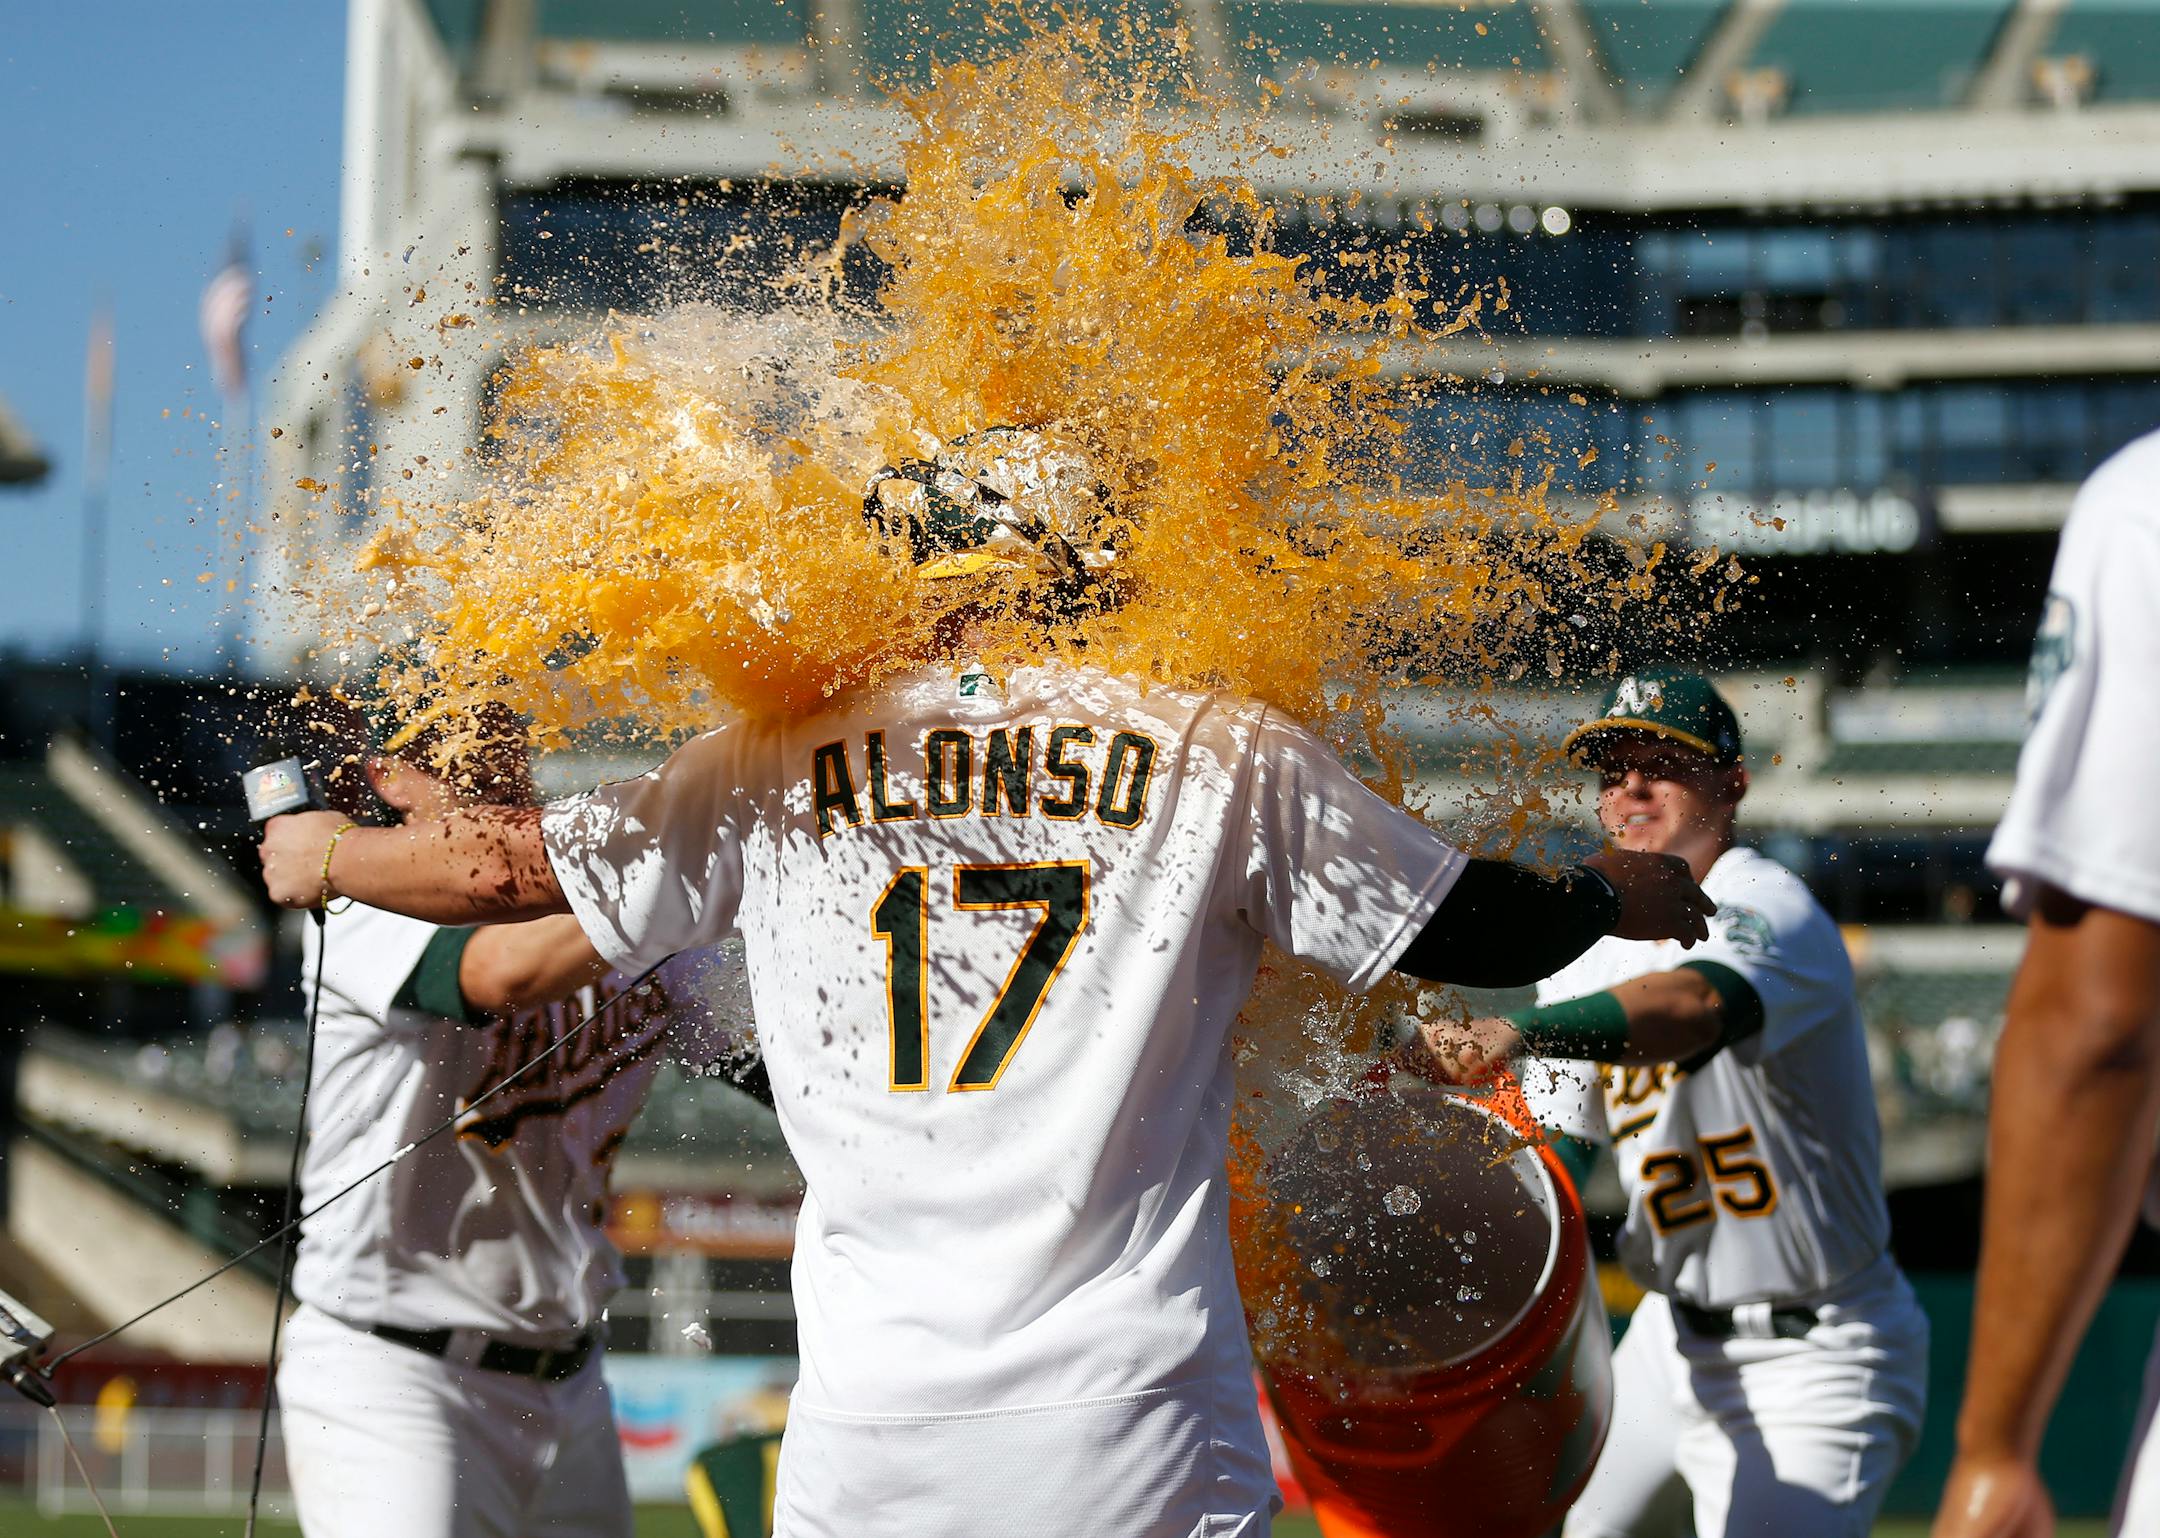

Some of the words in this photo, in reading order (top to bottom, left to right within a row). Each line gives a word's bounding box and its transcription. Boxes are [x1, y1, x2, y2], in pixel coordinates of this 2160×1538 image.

[812, 724, 1159, 839] ALONSO
[870, 859, 1091, 1094] 17
[1641, 1125, 1779, 1237] 25
